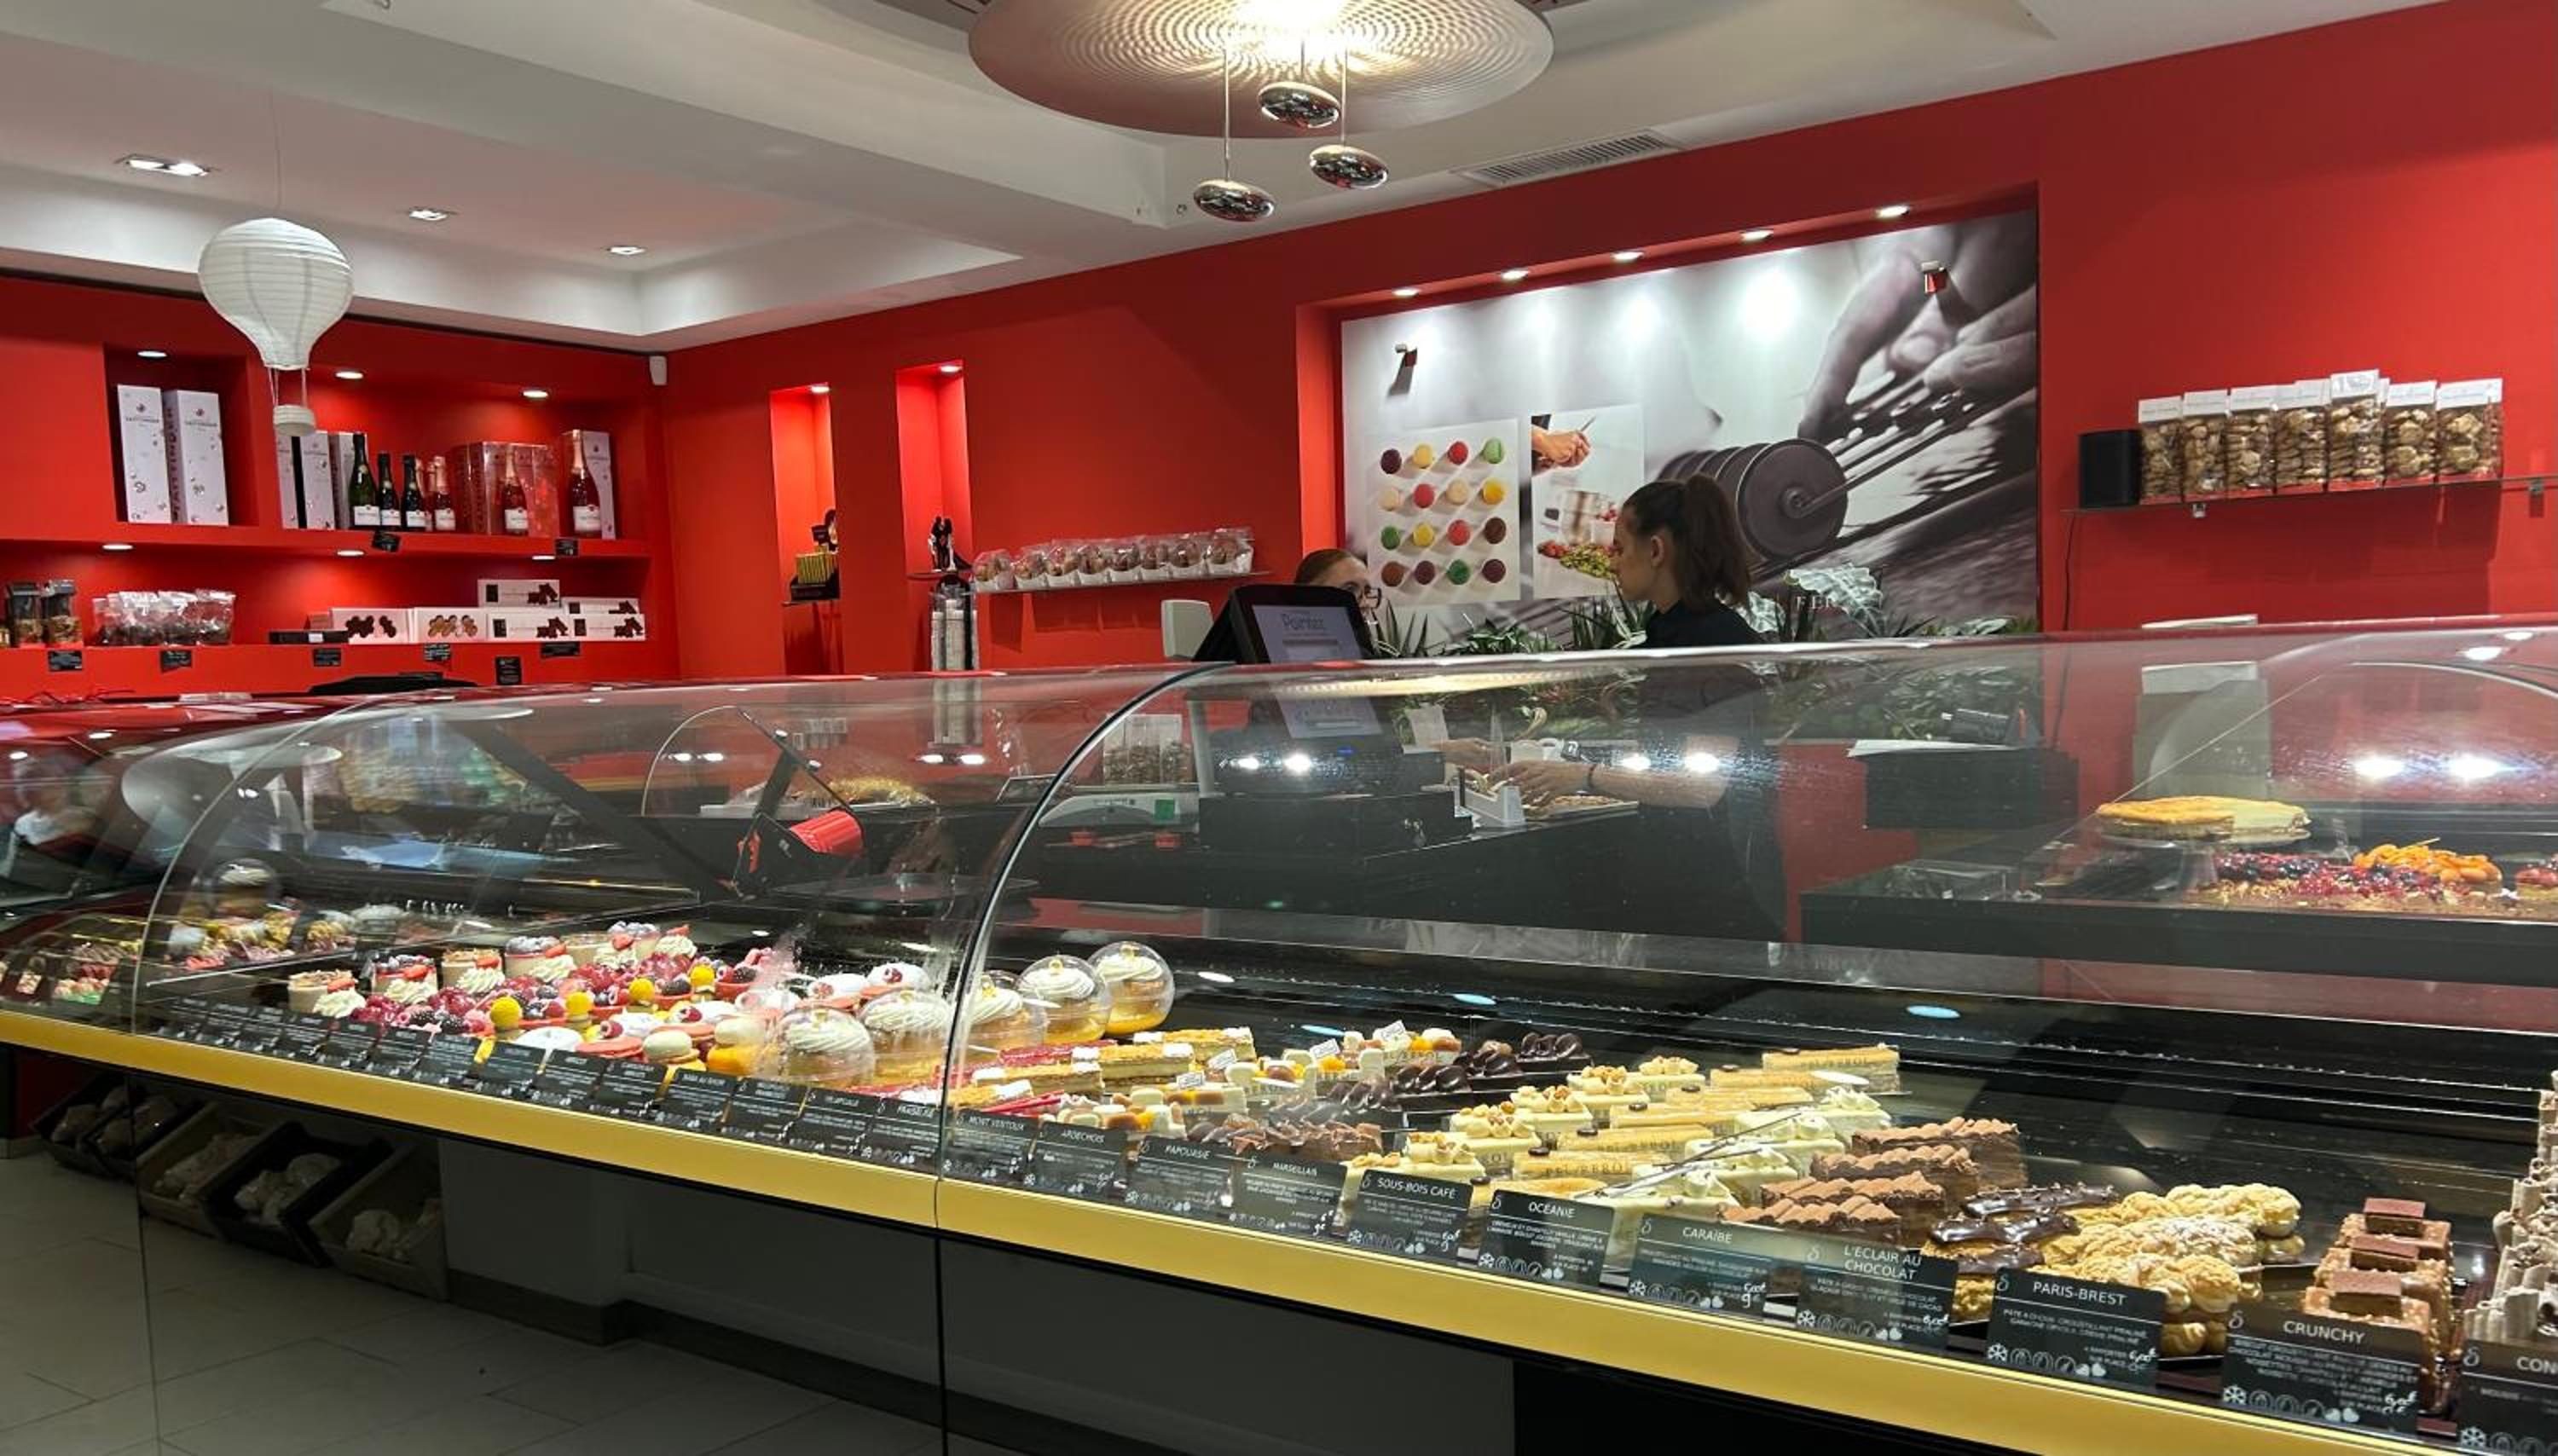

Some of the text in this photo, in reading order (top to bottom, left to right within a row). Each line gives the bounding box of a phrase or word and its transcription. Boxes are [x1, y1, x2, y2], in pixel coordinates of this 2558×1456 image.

[1377, 1177, 1428, 1194] SOUS-BOIS
[1844, 1259, 1917, 1280] CHOCOLAT
[1902, 1254, 1922, 1267] AU
[2033, 1281, 2128, 1306] PARIS-BREST
[2283, 1320, 2366, 1344] CRUNCHY
